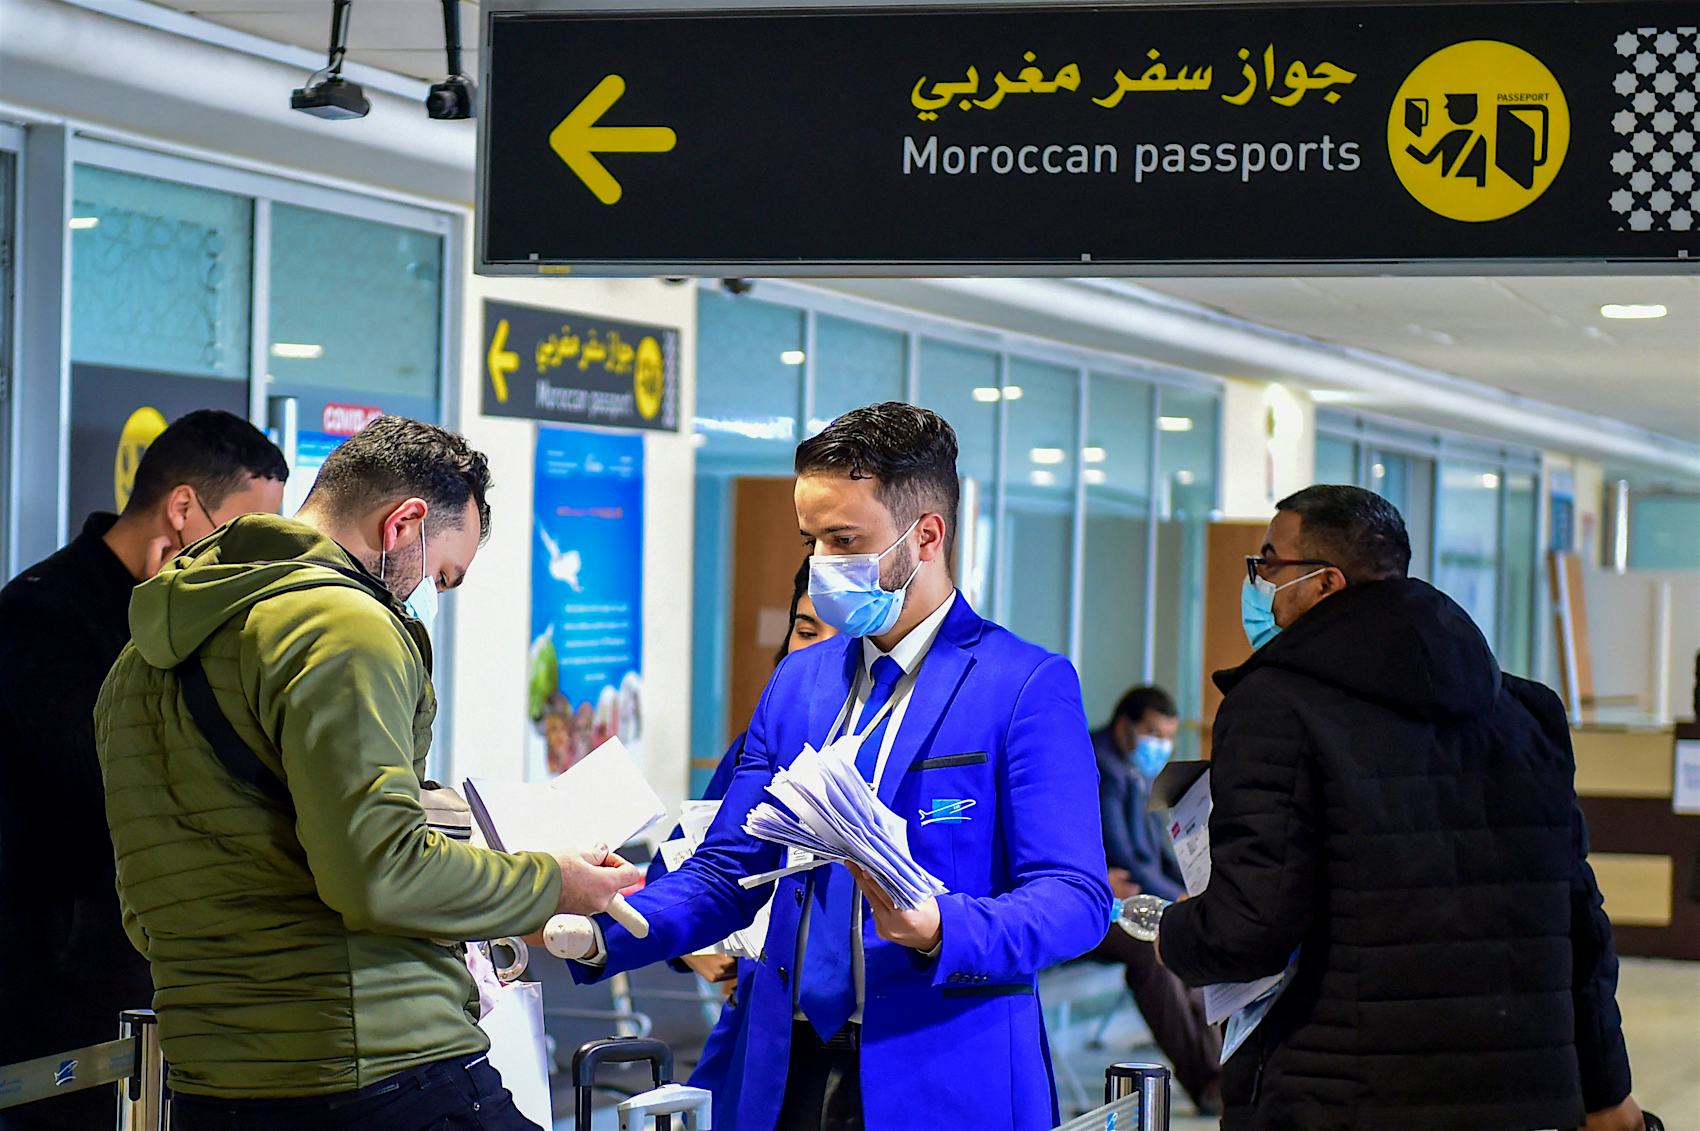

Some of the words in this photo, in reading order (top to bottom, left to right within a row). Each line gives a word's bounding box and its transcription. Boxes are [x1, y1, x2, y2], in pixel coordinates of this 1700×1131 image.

[911, 51, 1081, 121] مغربي
[1092, 48, 1212, 108] سفر
[1222, 44, 1357, 107] جواز
[1496, 93, 1550, 102] PASSEPORT
[902, 136, 1118, 176] Moroccan
[1134, 134, 1362, 183] passports
[322, 405, 383, 433] COVID-
